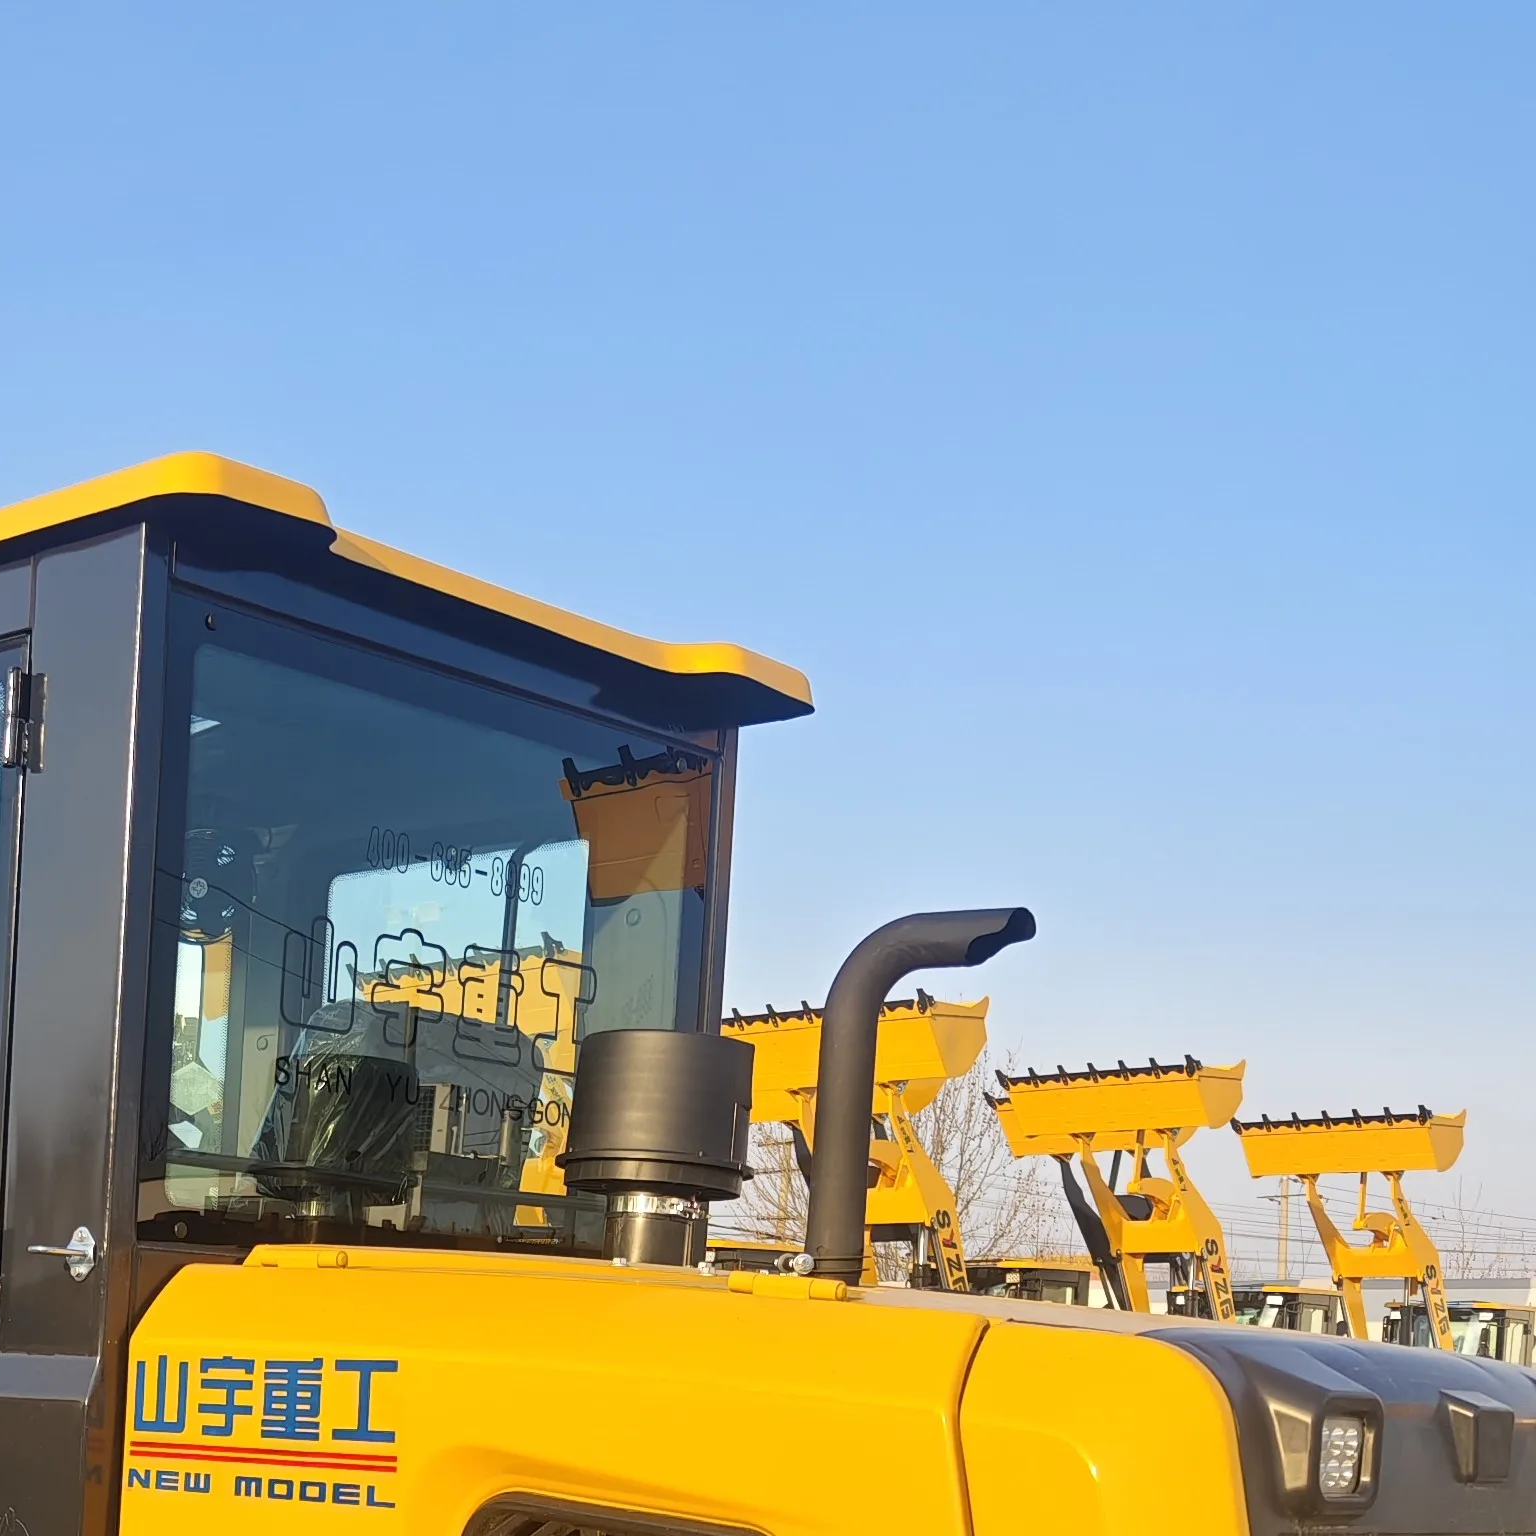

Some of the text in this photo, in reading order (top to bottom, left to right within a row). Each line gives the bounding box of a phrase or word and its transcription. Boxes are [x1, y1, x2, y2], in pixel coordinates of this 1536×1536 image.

[274, 1054, 353, 1096] SHAN
[386, 1072, 421, 1106] YU
[133, 1354, 399, 1444] 山宇重工
[127, 1467, 396, 1509] NEW MODEL
